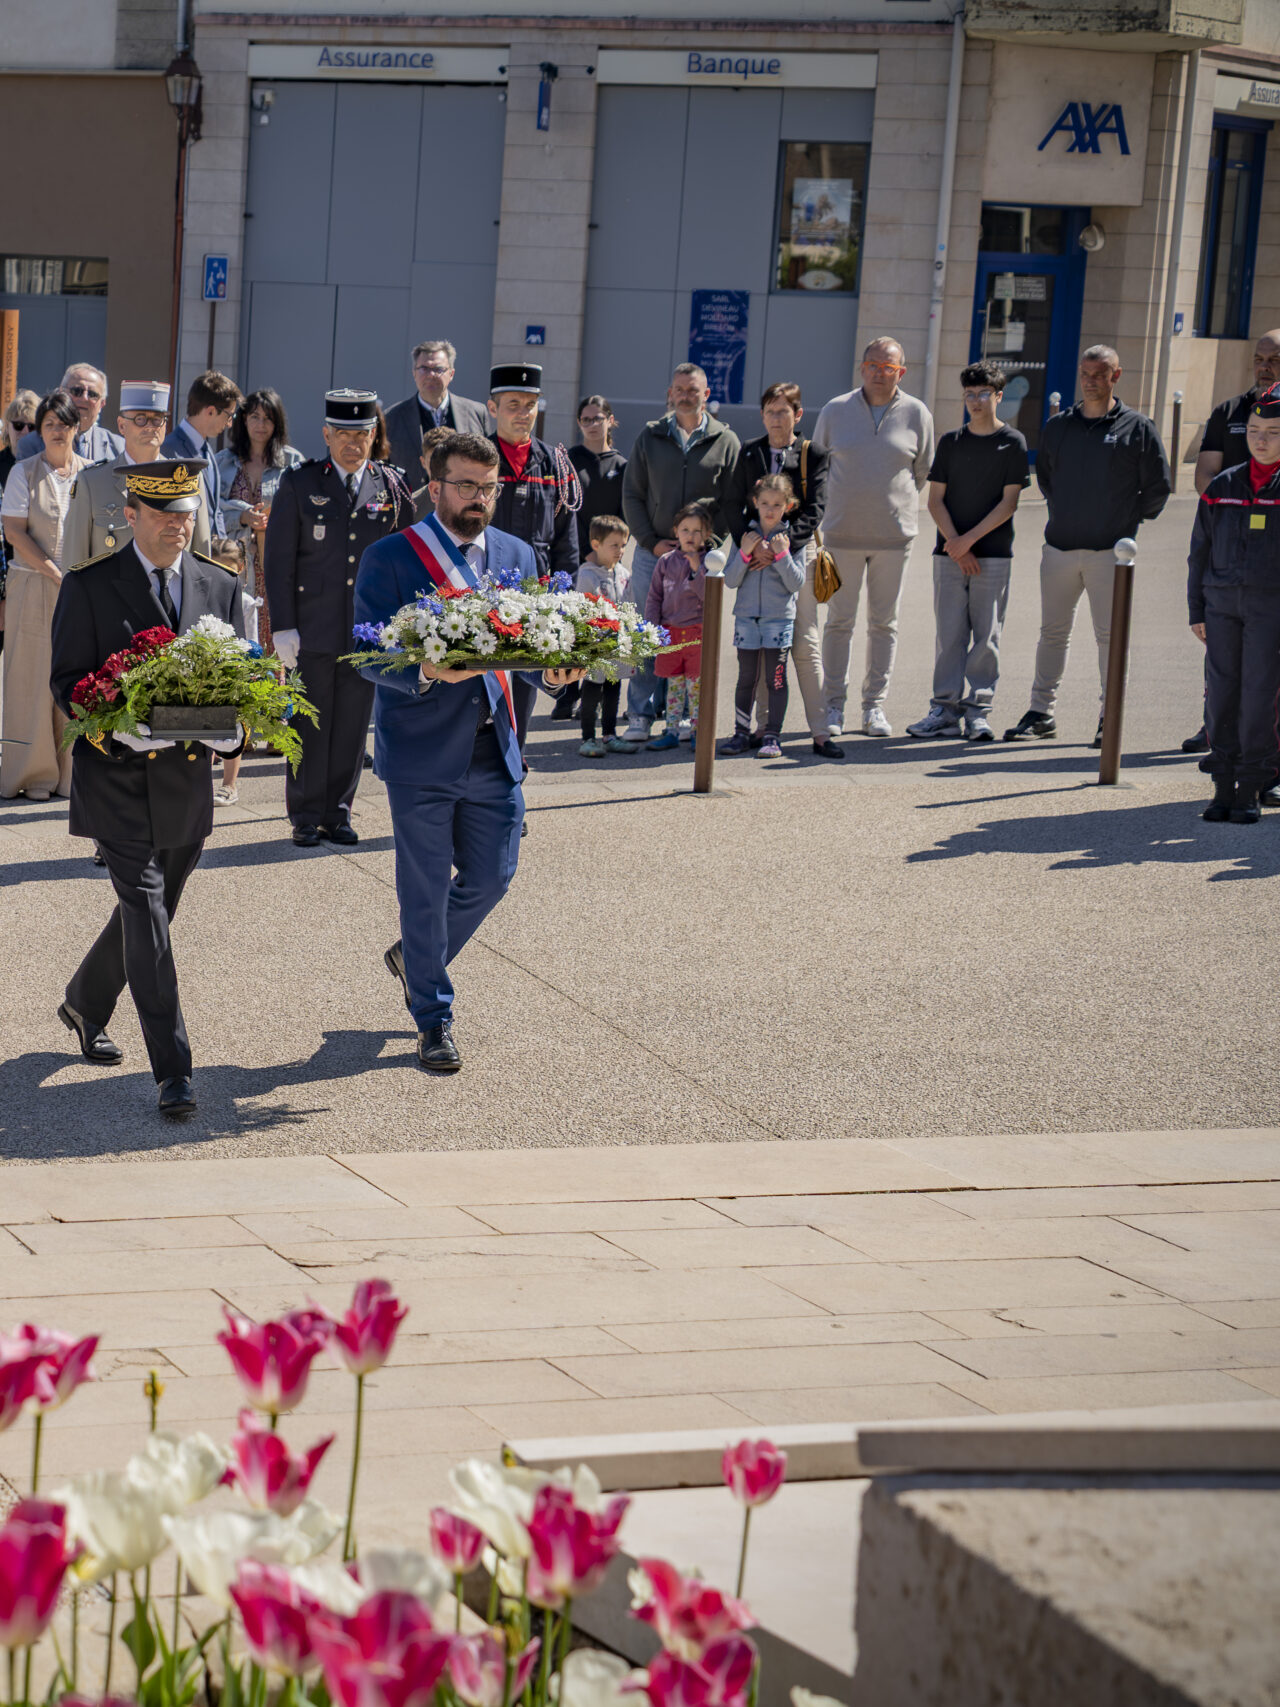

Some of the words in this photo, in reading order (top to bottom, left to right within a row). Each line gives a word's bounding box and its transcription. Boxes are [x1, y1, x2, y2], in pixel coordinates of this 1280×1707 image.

[317, 46, 435, 69] Assurance
[687, 52, 781, 80] Banque
[1036, 101, 1131, 155] AXA
